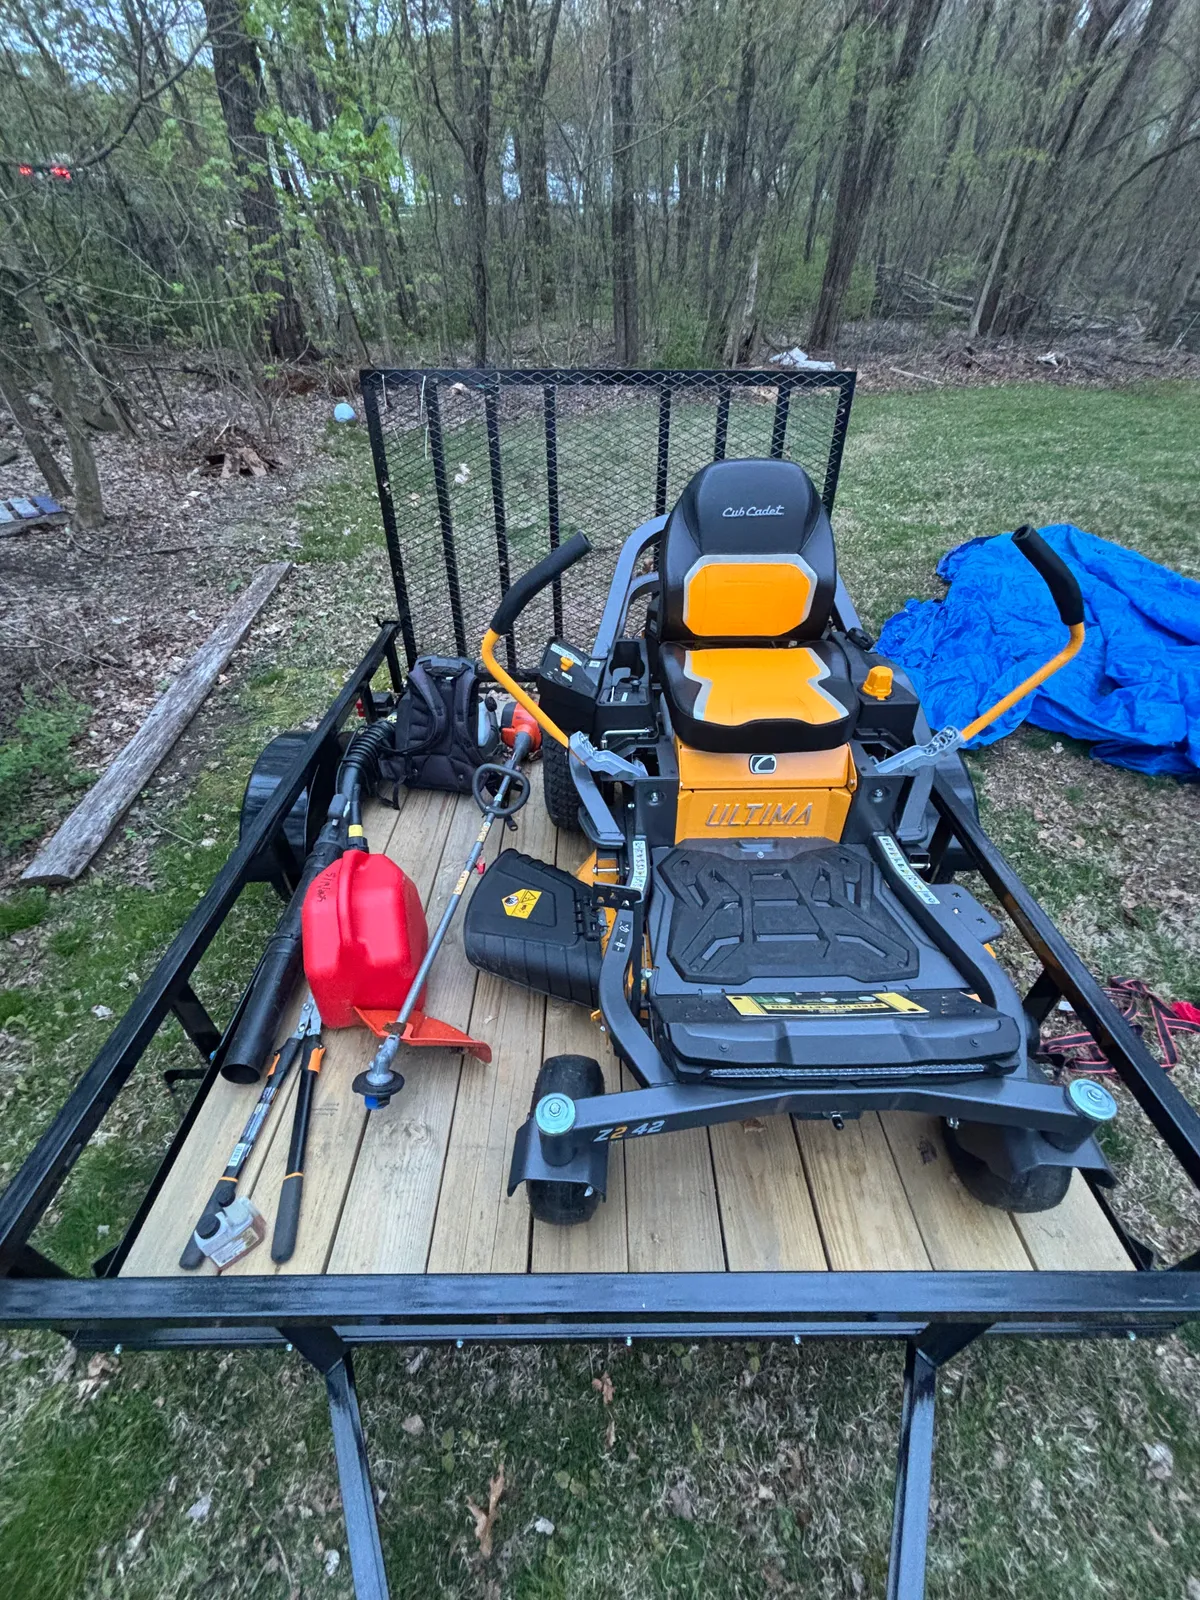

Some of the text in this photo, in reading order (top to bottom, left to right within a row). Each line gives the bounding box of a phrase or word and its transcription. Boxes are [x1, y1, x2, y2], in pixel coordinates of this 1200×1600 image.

[722, 504, 785, 518] Cub Cadet
[705, 802, 813, 826] ULTIMA
[592, 1120, 665, 1142] Z2 42
